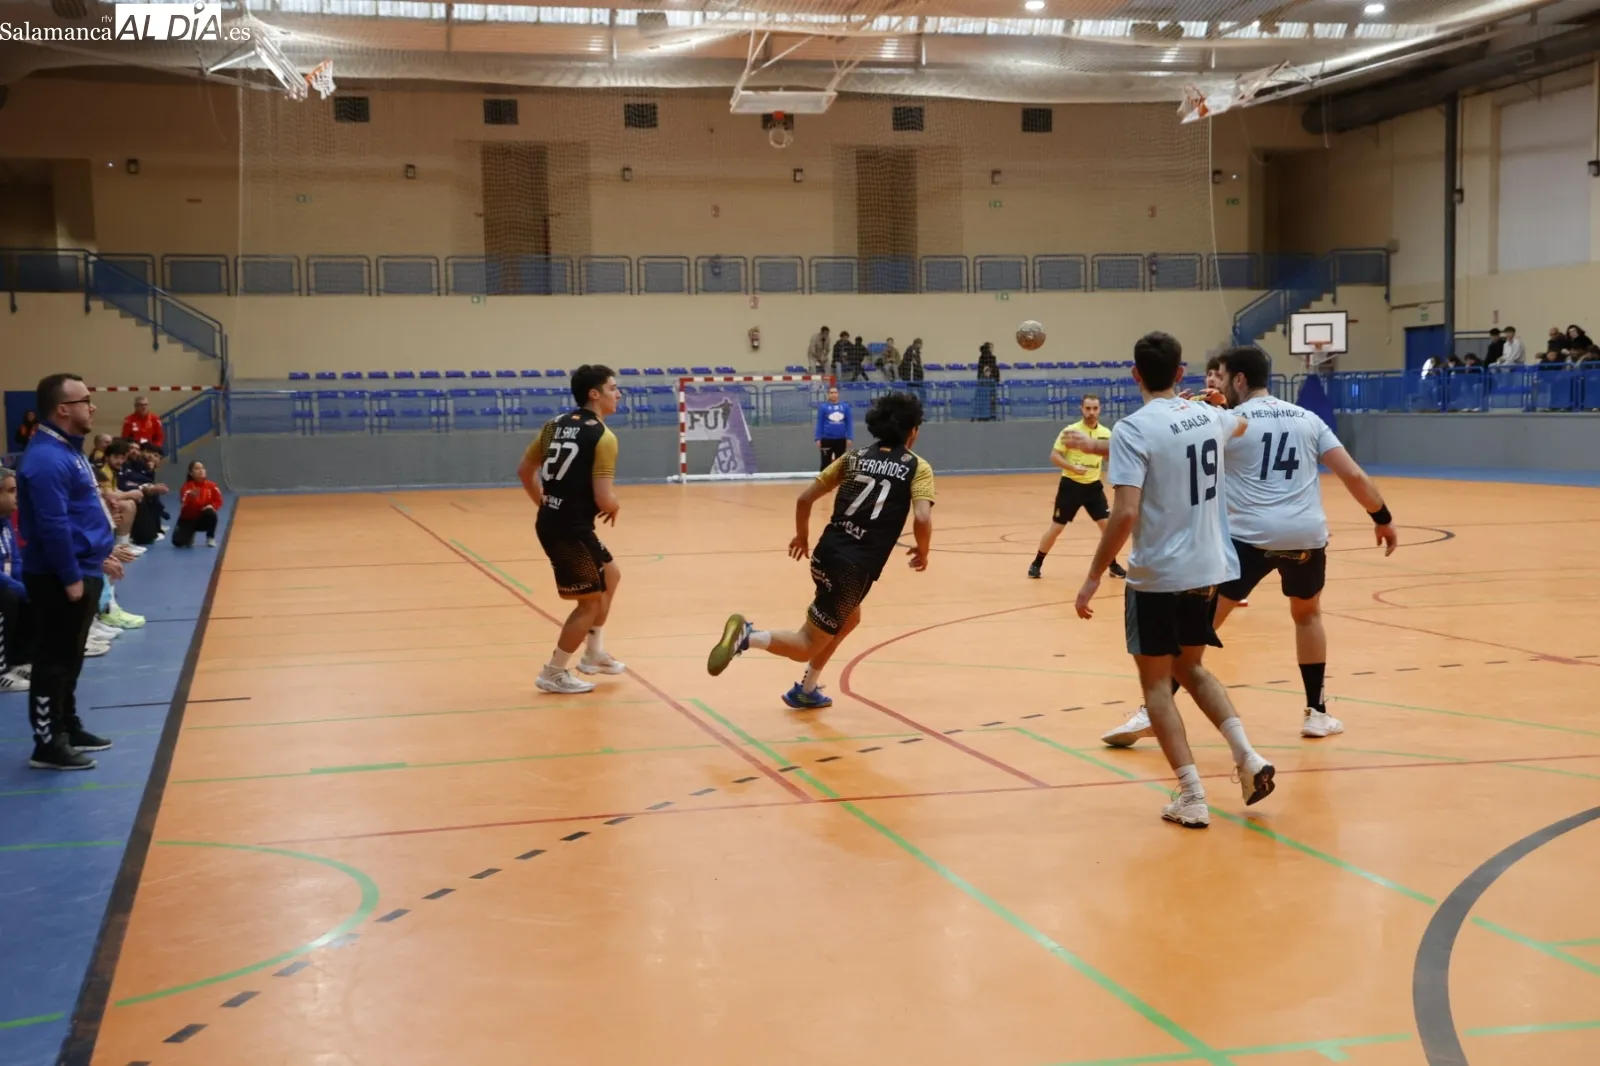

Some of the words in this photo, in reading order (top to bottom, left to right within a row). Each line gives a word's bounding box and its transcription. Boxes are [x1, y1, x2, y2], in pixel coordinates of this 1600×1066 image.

[1180, 414, 1212, 431] BALSA
[542, 441, 580, 481] 27
[1186, 438, 1219, 507] 19
[1260, 431, 1300, 481] 14
[844, 474, 892, 520] 71
